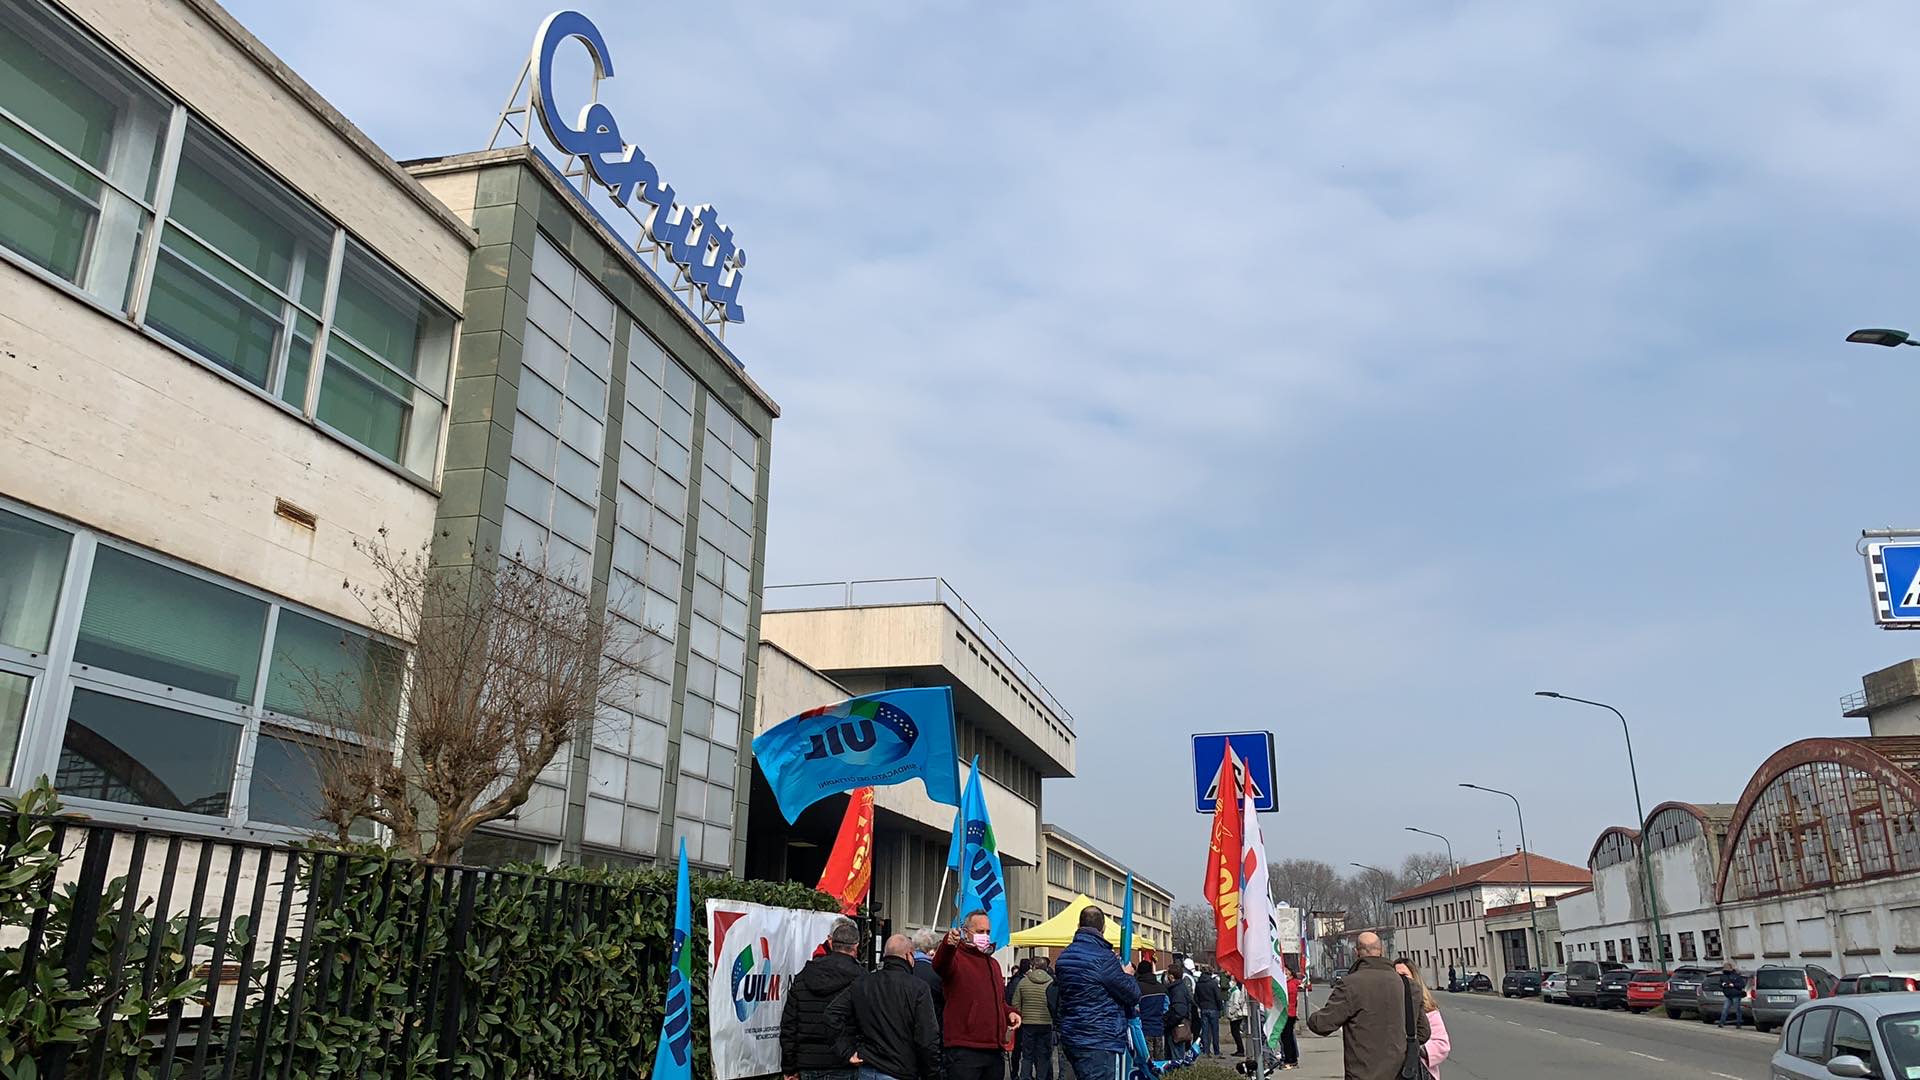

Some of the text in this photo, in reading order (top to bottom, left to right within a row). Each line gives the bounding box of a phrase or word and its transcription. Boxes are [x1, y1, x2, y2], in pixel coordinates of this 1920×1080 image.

[531, 10, 746, 323] Cerutti
[970, 848, 1004, 913] UIL
[743, 974, 781, 1003] UILM
